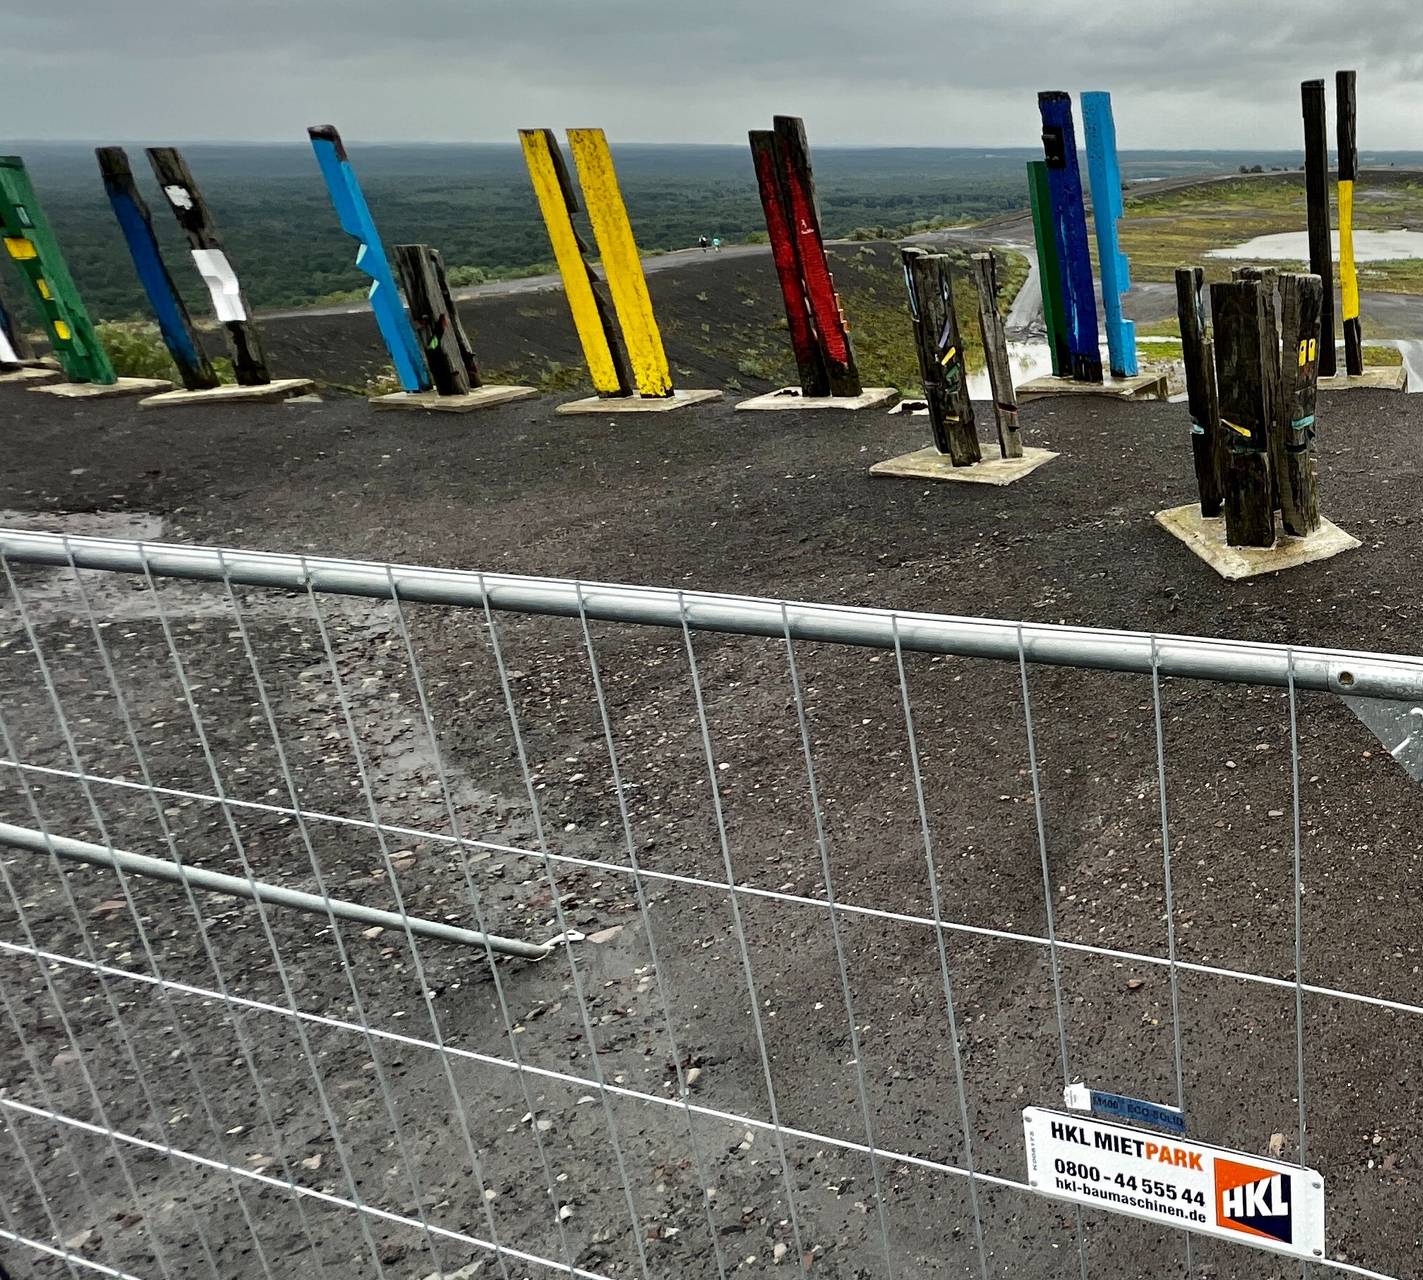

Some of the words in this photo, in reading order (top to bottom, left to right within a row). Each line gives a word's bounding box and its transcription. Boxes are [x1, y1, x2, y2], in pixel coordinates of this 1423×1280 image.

[1127, 1104, 1149, 1116] ECO
[1152, 1110, 1184, 1126] SOLID
[1051, 1121, 1090, 1146] HKL
[1094, 1131, 1203, 1171] MIETPARK
[1054, 1158, 1100, 1182] 0800
[1114, 1173, 1138, 1191] 44
[1142, 1179, 1177, 1201] 555
[1181, 1188, 1206, 1207] 44
[1055, 1177, 1207, 1223] hkl-baumaschinen.de
[1222, 1174, 1289, 1218] HKL
